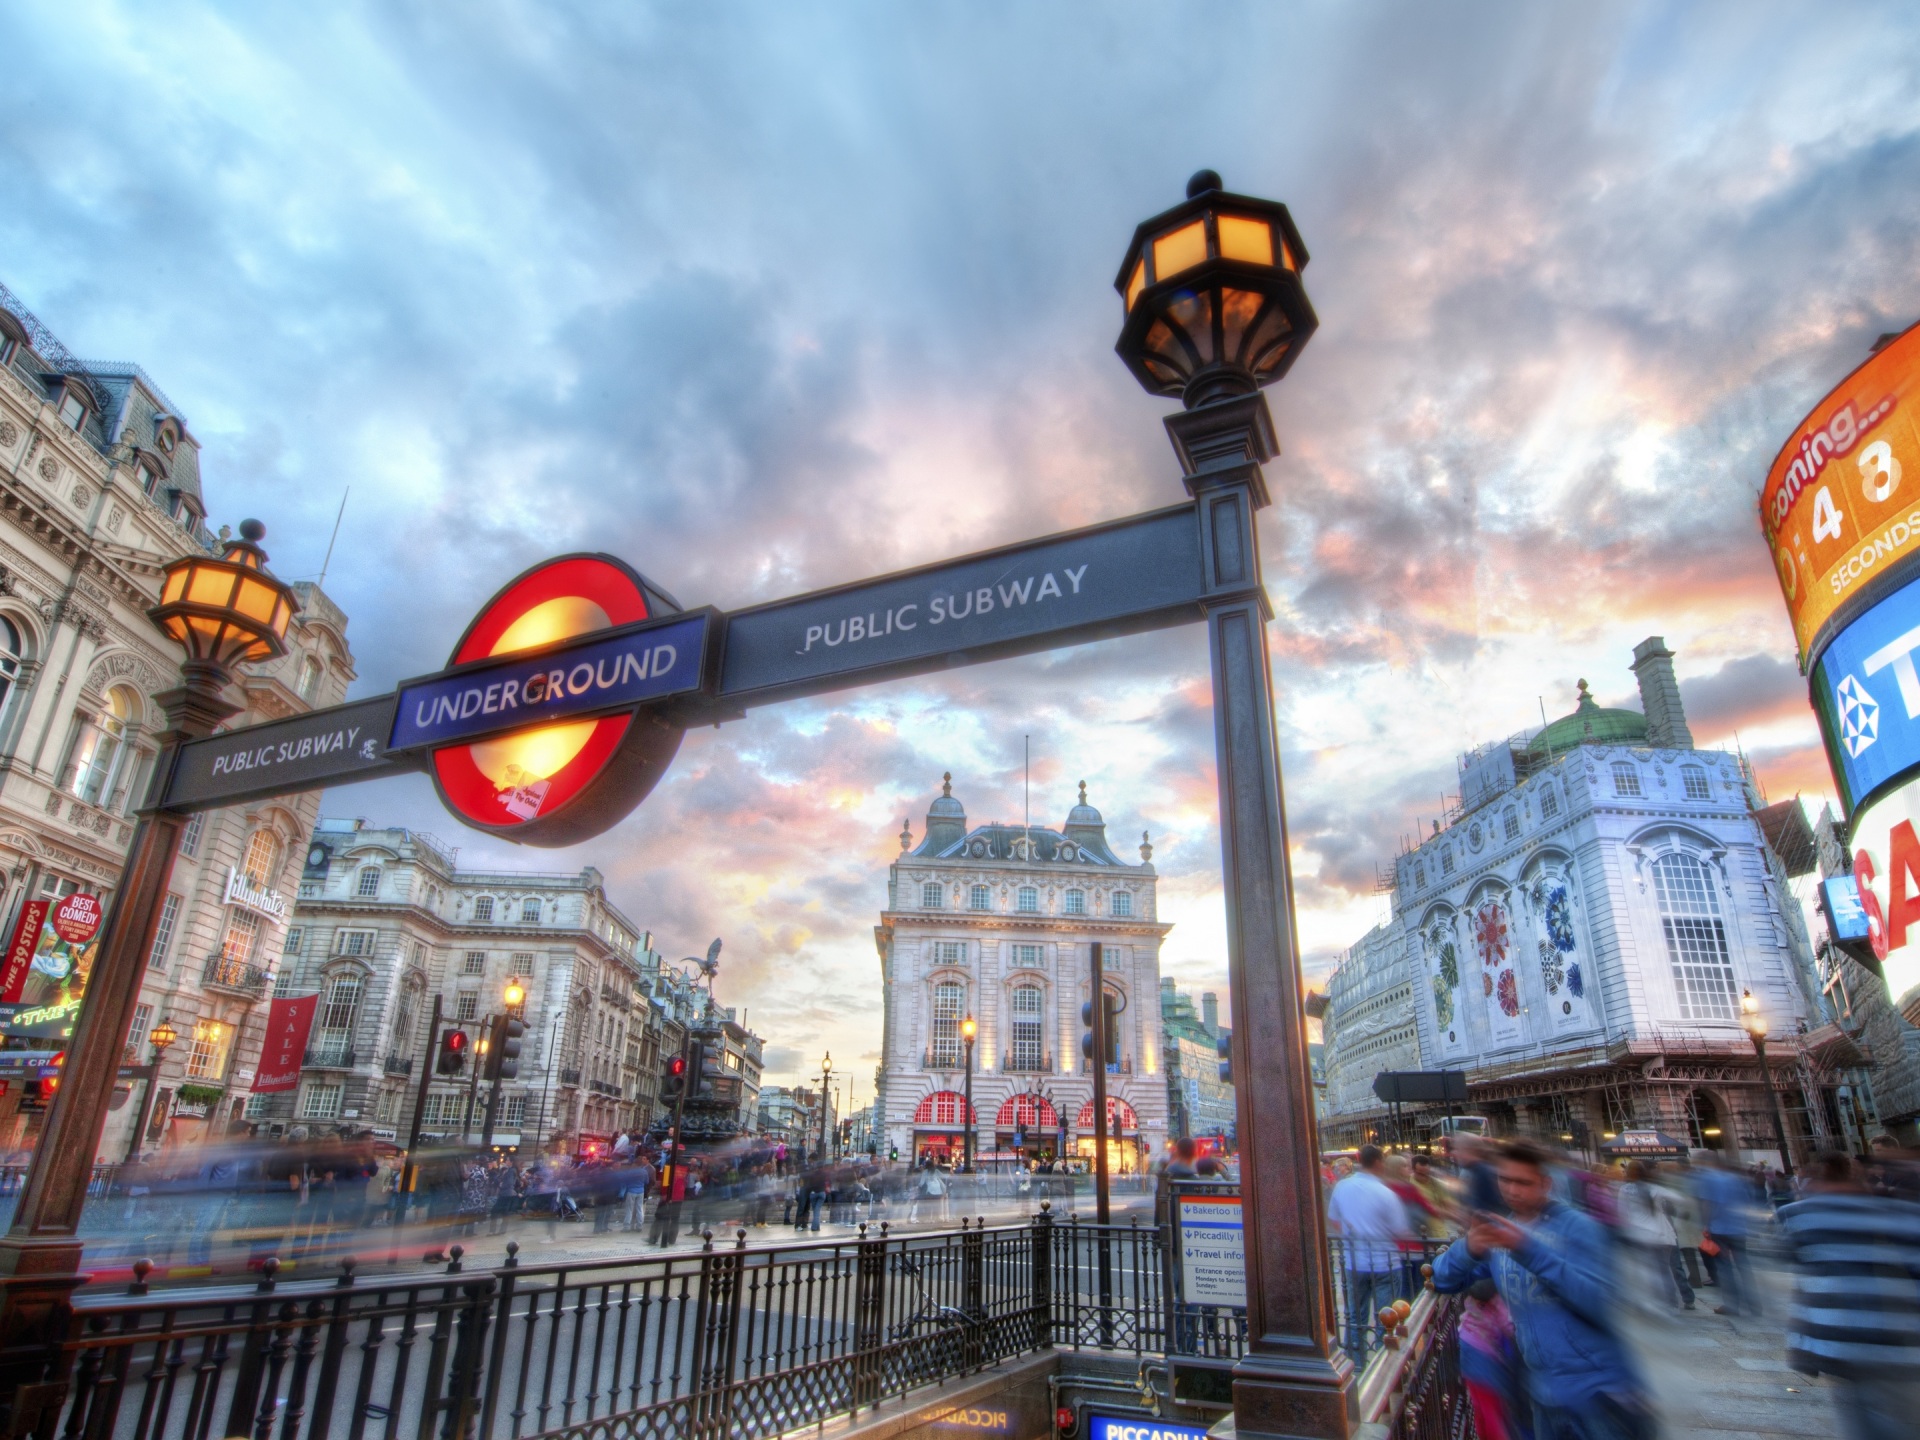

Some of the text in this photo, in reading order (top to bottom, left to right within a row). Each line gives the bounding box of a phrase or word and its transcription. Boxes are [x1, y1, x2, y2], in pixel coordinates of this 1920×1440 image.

[1830, 511, 1920, 594] SECONDS
[804, 564, 1088, 651] PUBLIC SUBWAY
[415, 644, 677, 729] UNDERGROUND
[212, 745, 274, 776] PUBLIC
[276, 727, 360, 763] SUBWAY
[72, 896, 95, 912] BEST
[222, 866, 287, 925] Lillywhites
[60, 906, 98, 925] COMEDY
[13, 947, 28, 968] 39
[280, 1006, 298, 1065] SALE
[1192, 1206, 1230, 1215] Bakerloo
[1194, 1230, 1234, 1242] Piccadilly
[1194, 1250, 1221, 1259] Travel
[1195, 1267, 1222, 1275] Entrance
